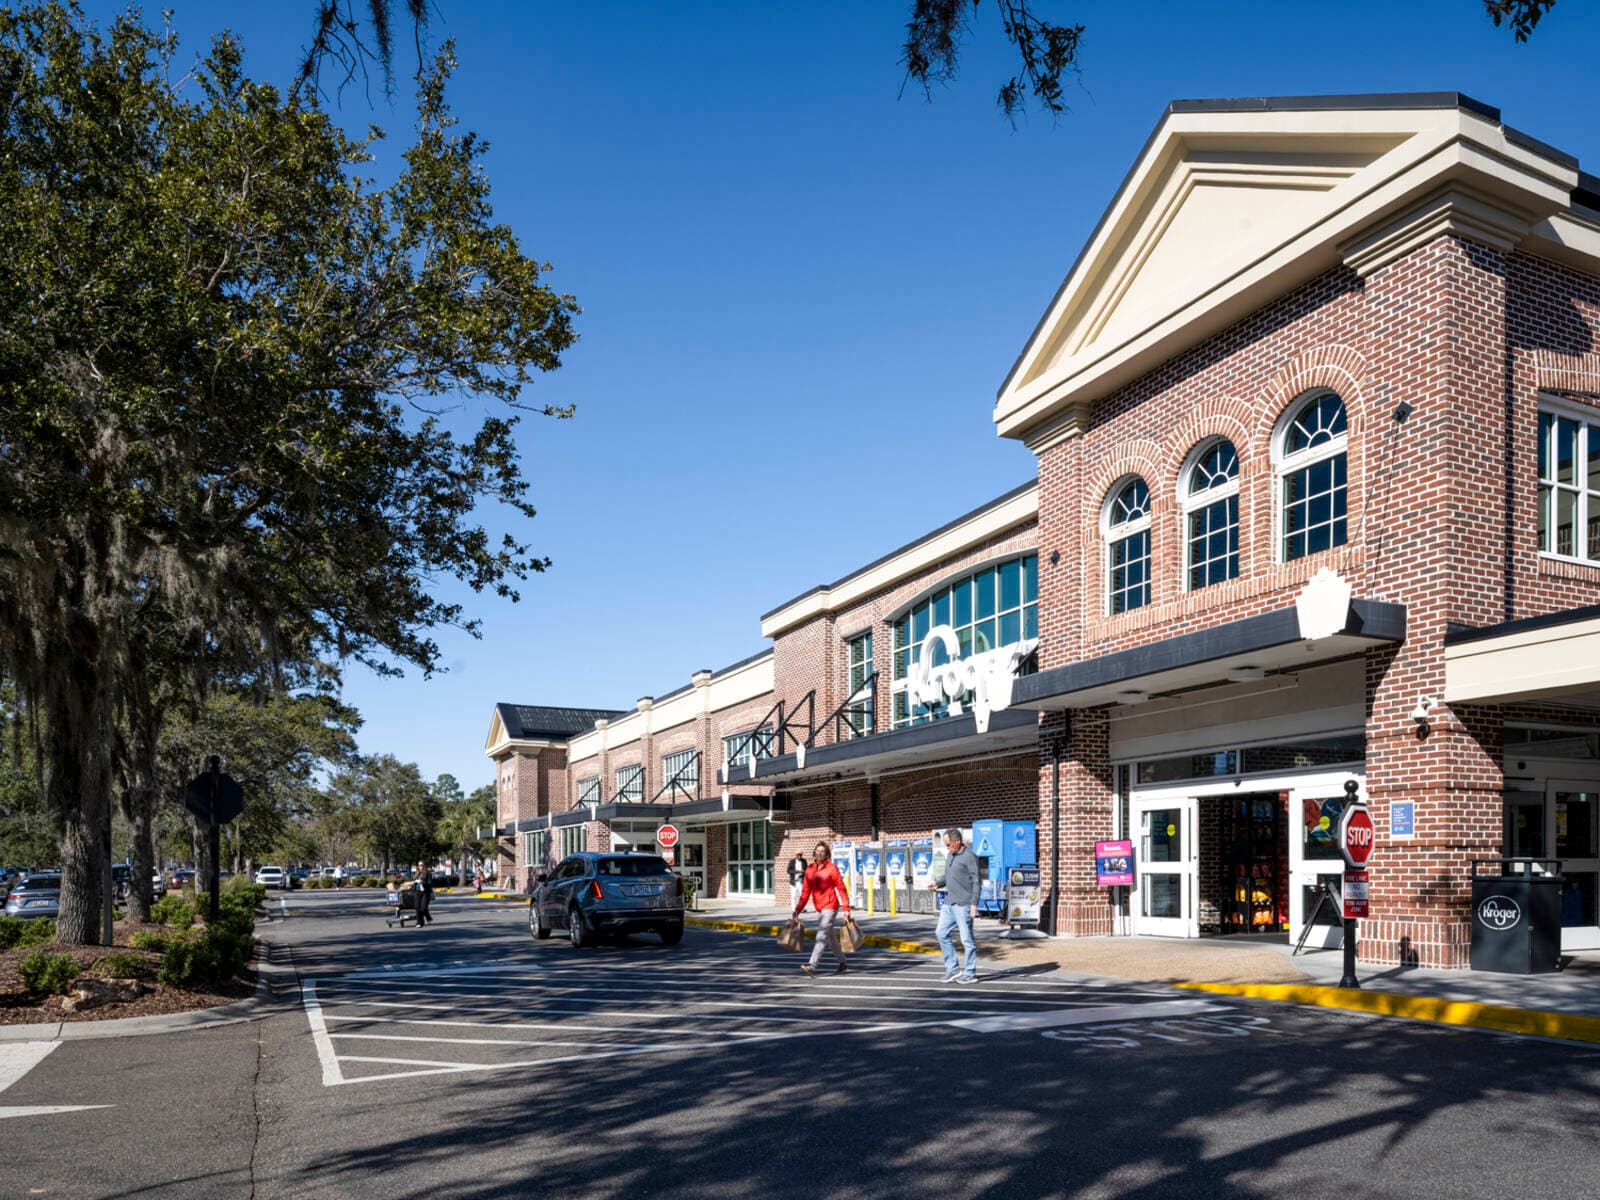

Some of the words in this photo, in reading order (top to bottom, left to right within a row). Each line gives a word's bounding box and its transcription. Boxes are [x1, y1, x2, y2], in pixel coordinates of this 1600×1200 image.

[659, 831, 676, 840] STOP
[1347, 826, 1372, 847] STOP
[1483, 901, 1517, 926] Kroger
[1040, 1014, 1283, 1048] STOP
